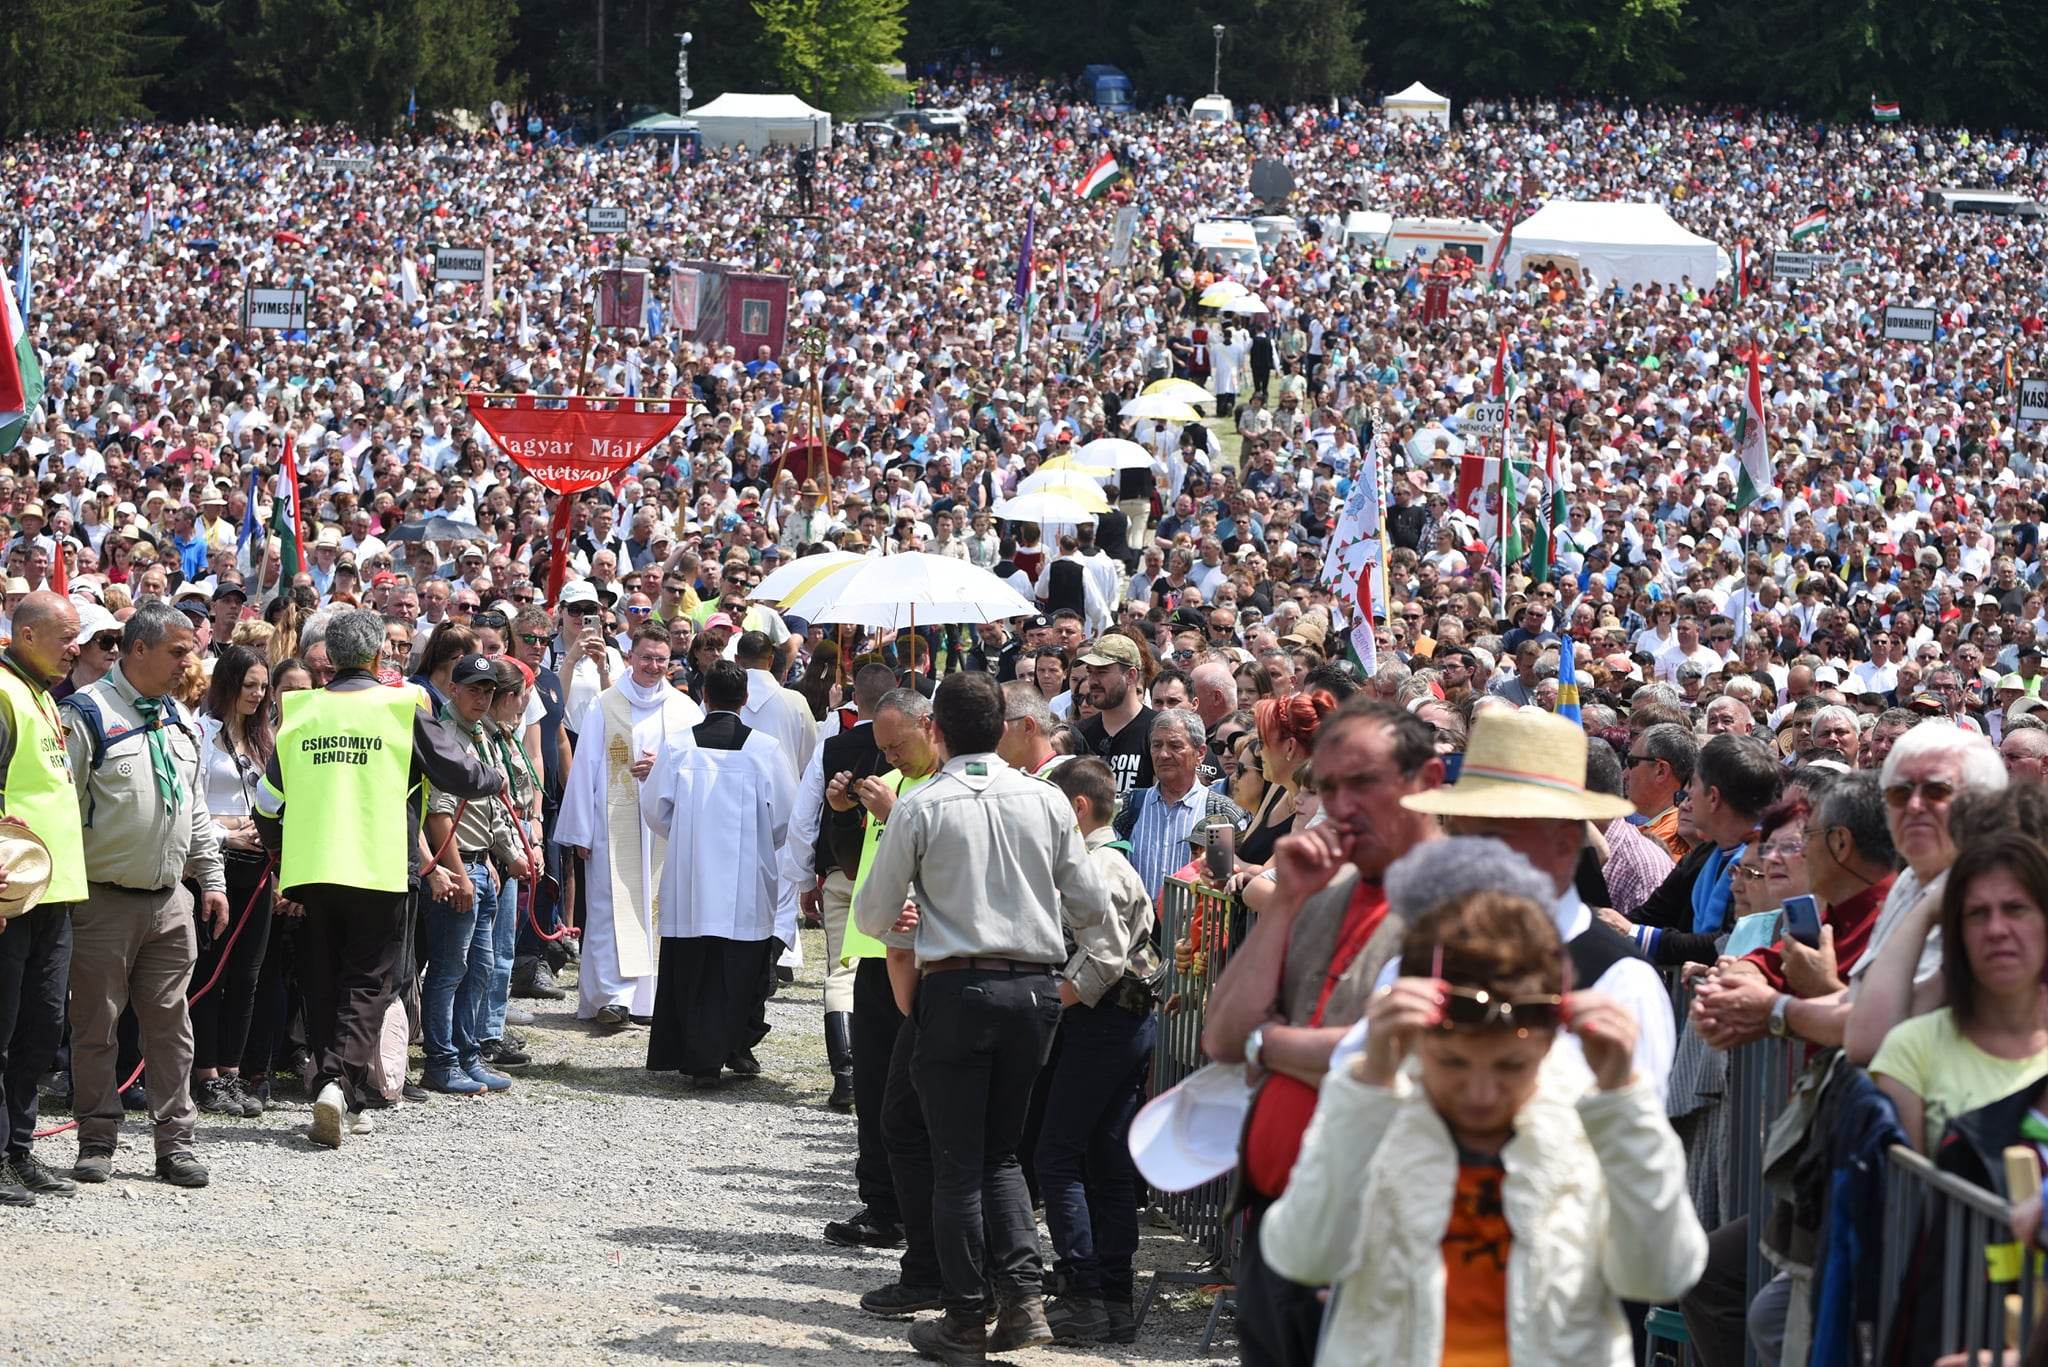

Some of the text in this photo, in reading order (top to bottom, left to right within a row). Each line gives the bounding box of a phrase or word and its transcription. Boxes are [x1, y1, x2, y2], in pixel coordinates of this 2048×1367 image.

[438, 254, 482, 271] HÁROMSZÉK
[1887, 317, 1932, 330] UDVARHELY
[302, 735, 382, 751] CSÍKSOMLYÓ
[313, 750, 368, 765] RENDEZŐ
